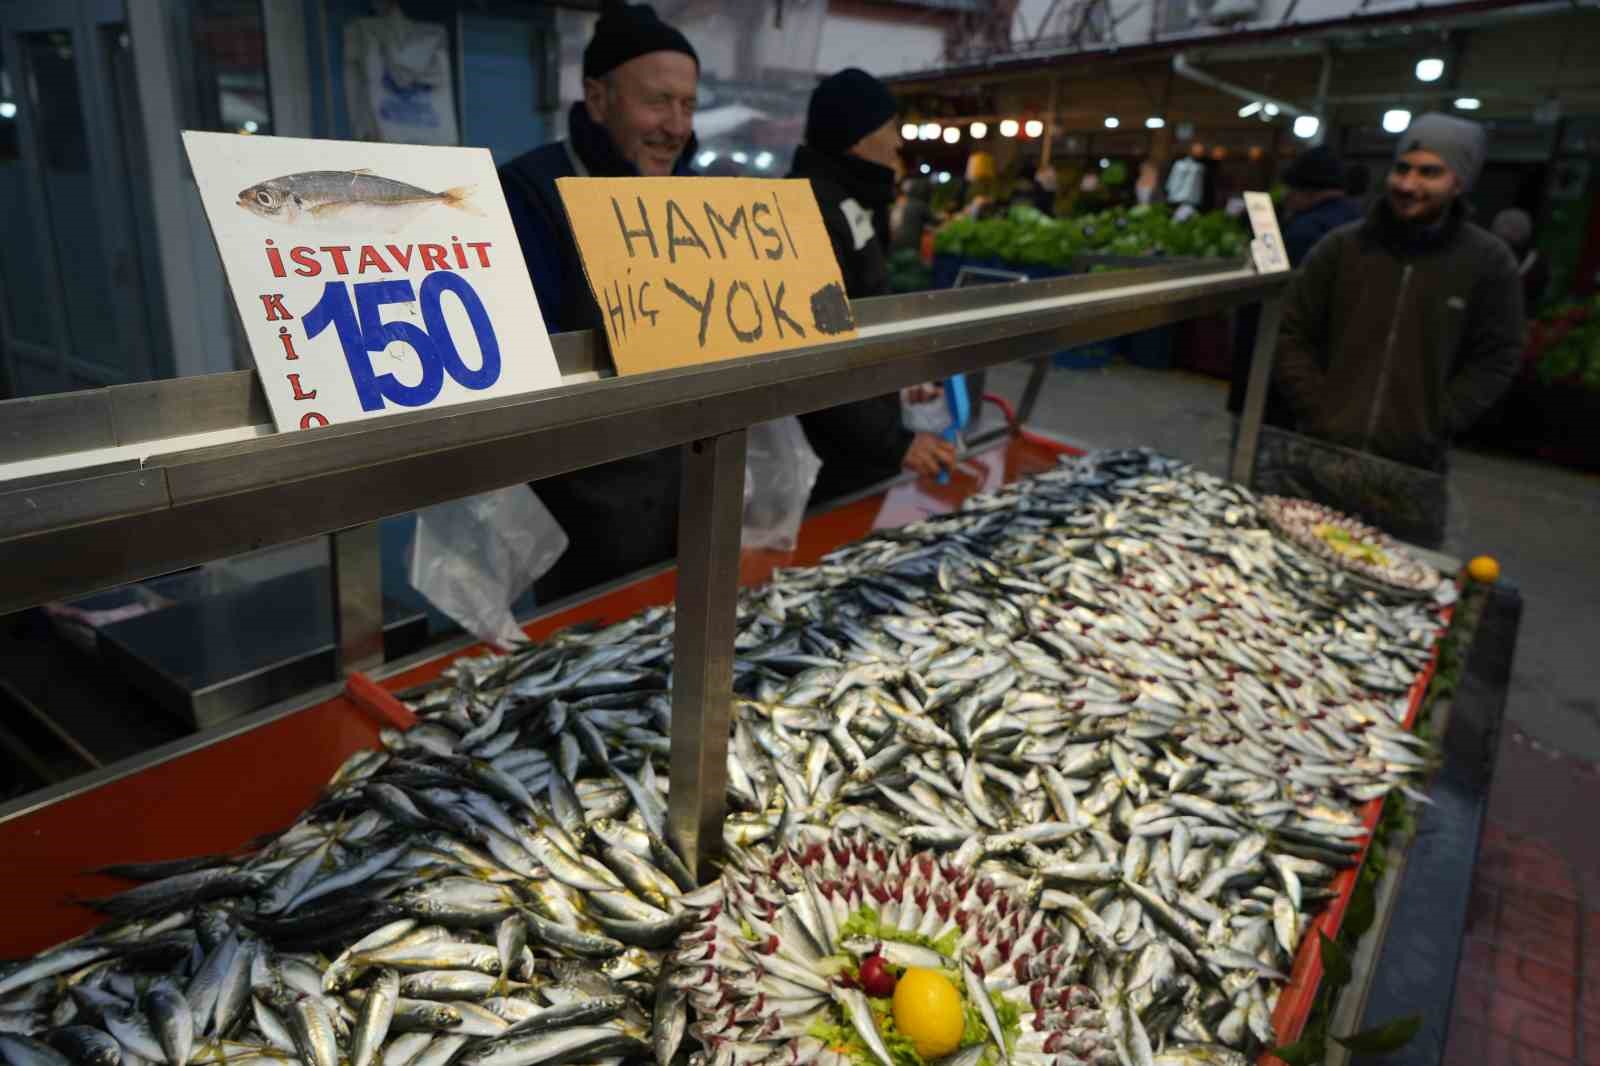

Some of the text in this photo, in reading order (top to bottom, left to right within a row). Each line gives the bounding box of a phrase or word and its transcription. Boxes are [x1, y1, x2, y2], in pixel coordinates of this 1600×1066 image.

[264, 235, 493, 278] İSTAVRİT
[301, 270, 501, 412] 150
[664, 277, 806, 348] YOK
